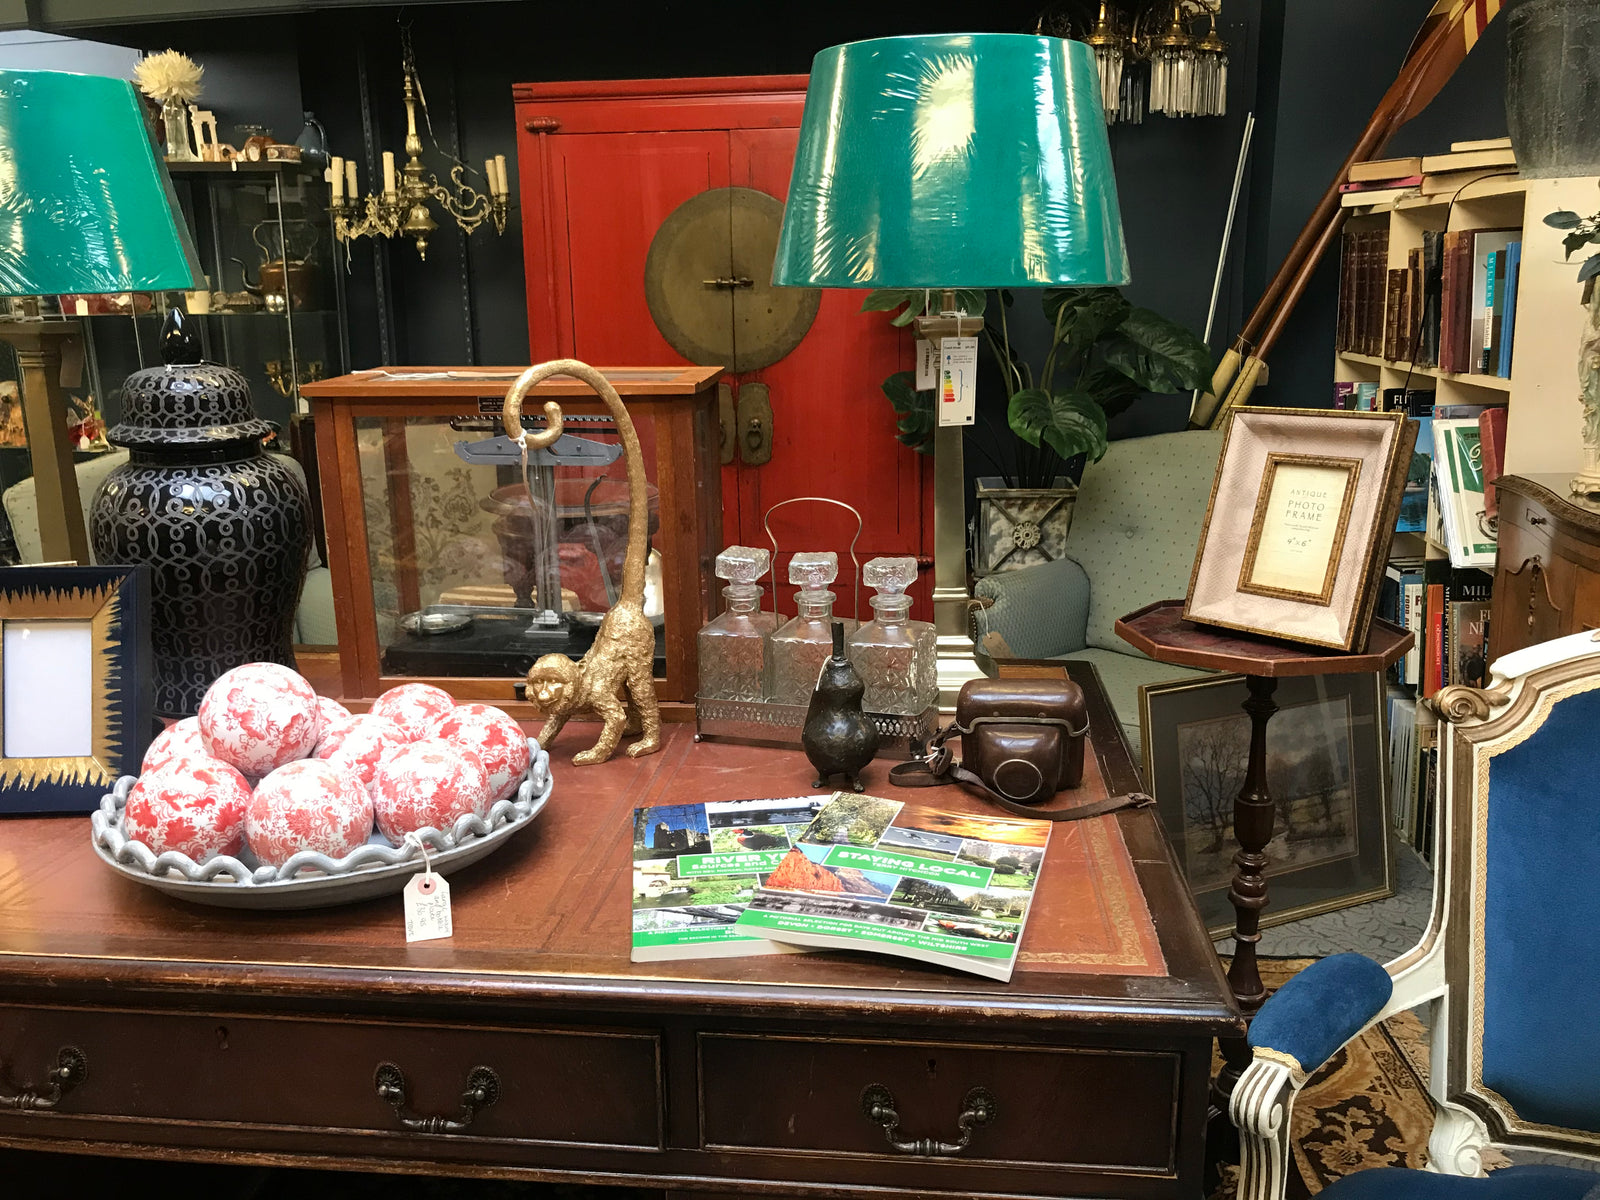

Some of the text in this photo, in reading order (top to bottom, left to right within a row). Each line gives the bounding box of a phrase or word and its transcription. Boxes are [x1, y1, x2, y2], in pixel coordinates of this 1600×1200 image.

[1290, 488, 1327, 499] ANTIQUE
[1287, 499, 1325, 511] PHOTO
[1285, 509, 1323, 521] FRAME
[702, 855, 761, 864] RIVER
[838, 851, 981, 880] STAYING LOCAL
[777, 920, 968, 951] DEVON DORSET SOMERSET WILTSHIRE
